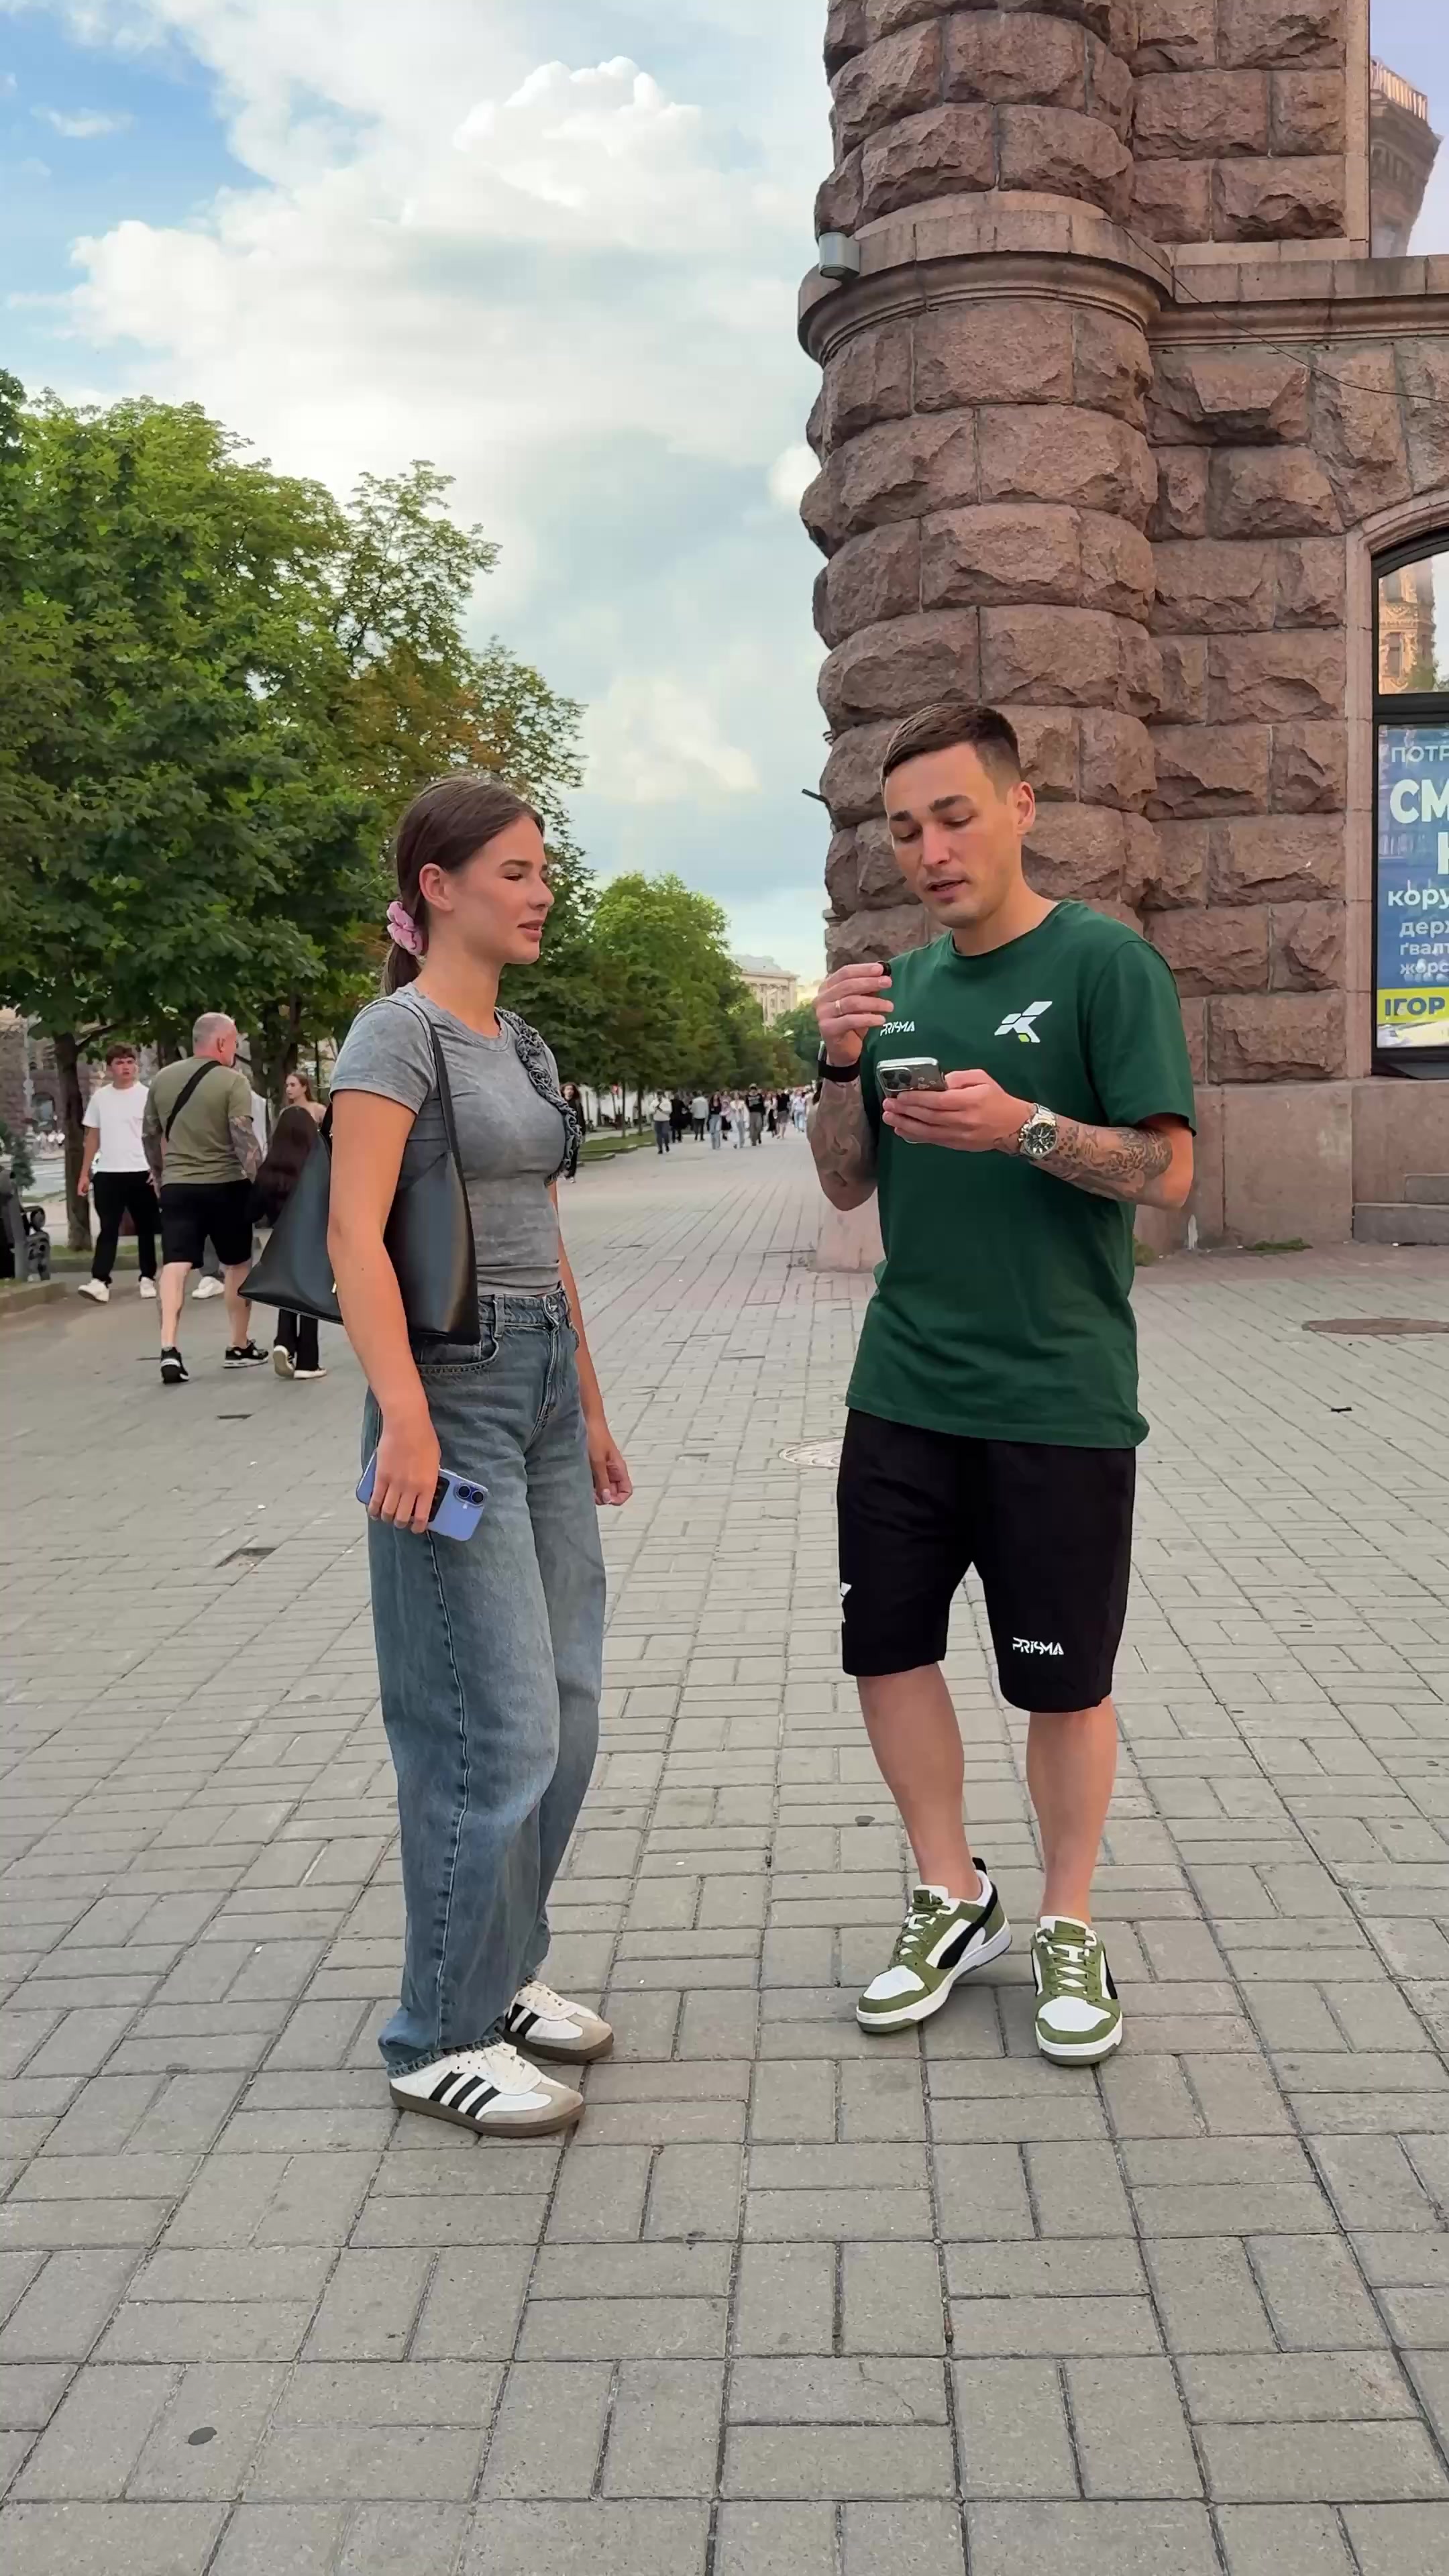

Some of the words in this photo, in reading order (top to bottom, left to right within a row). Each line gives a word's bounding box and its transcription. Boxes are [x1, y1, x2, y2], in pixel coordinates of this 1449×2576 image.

[1389, 778, 1449, 824] СМ
[1385, 997, 1445, 1016] ІГОР
[879, 1020, 915, 1036] PRISMA
[1012, 1636, 1064, 1656] PRISMA
